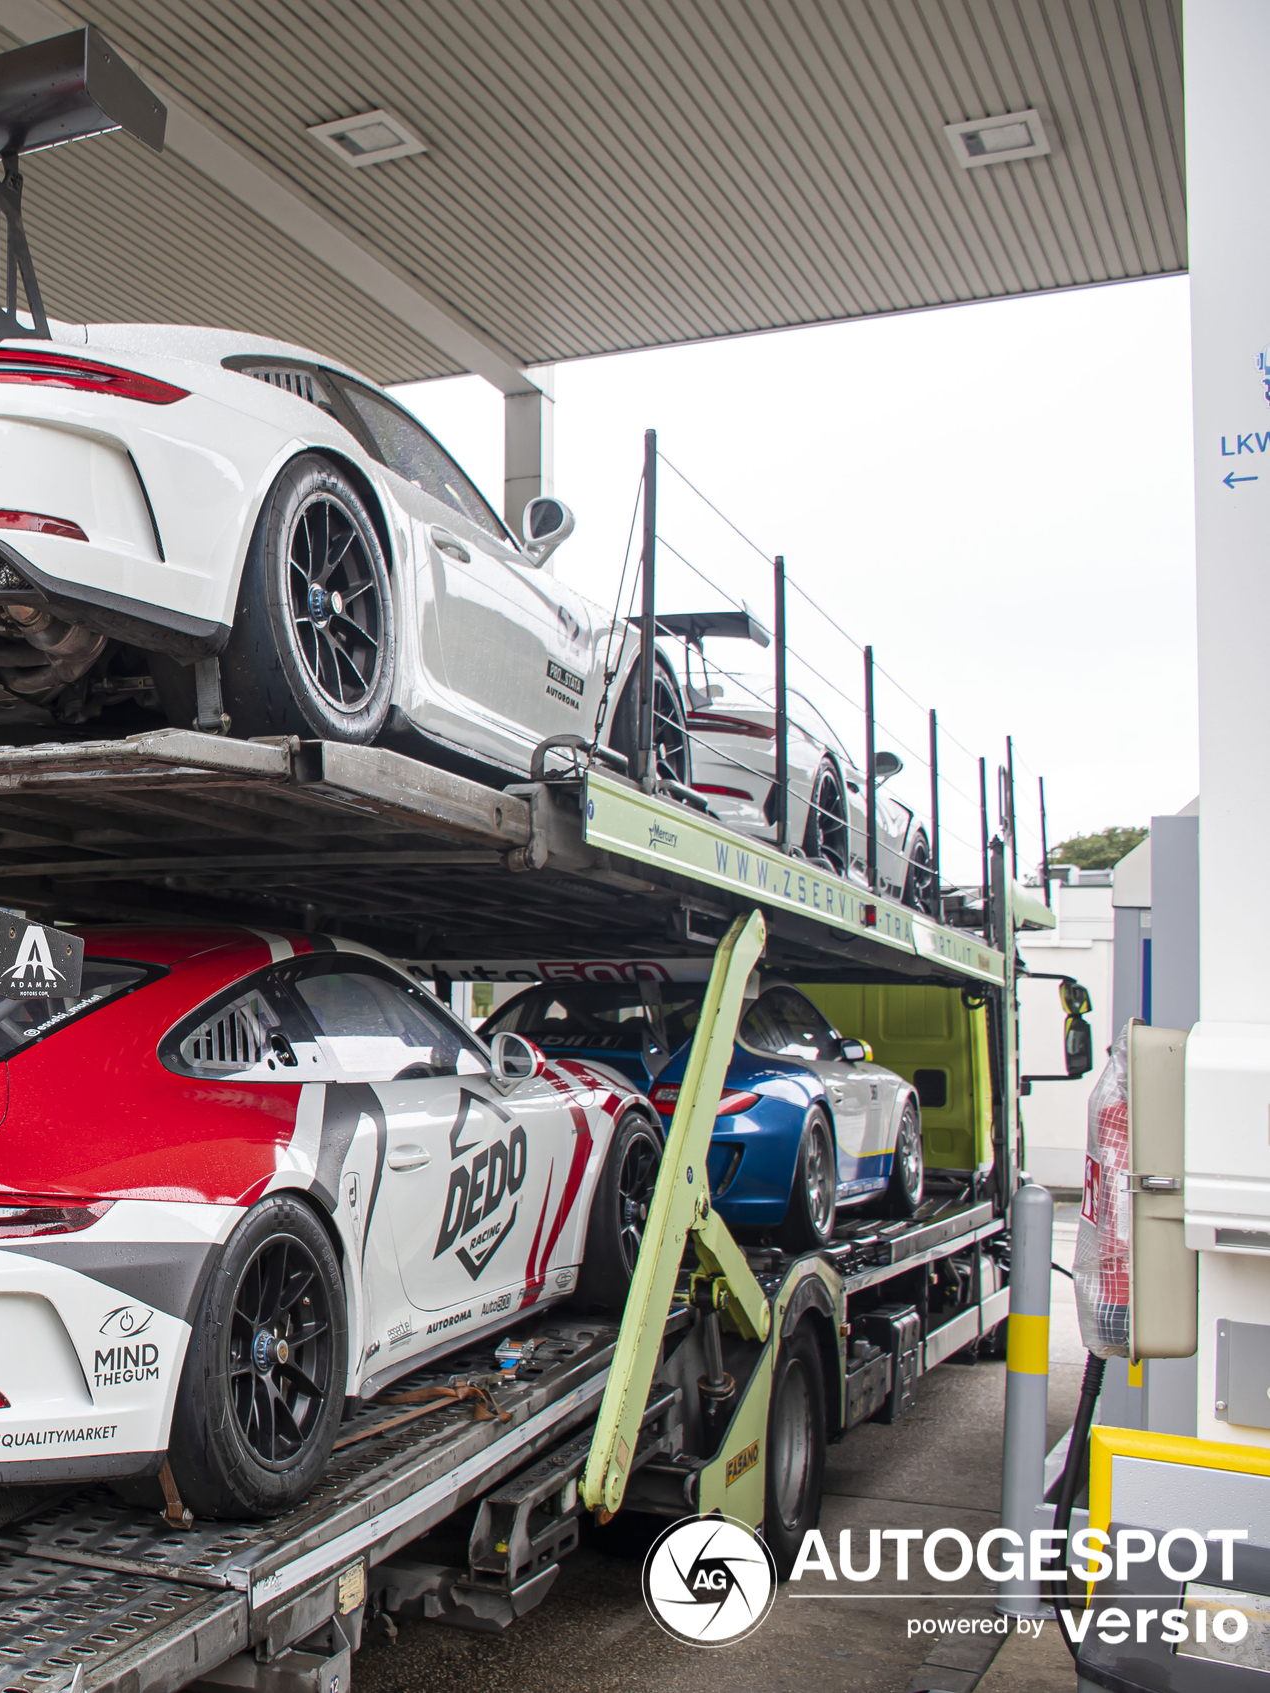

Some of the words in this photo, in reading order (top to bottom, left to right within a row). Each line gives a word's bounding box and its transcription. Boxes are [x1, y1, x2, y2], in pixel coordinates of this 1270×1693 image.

[546, 685, 580, 711] AUTOROMA
[654, 823, 678, 845] Mercury
[10, 981, 58, 989] ADAMAS
[433, 1125, 527, 1261] DEDO
[469, 1221, 501, 1251] RACING
[426, 1309, 472, 1336] AUTOROMA
[94, 1343, 159, 1373] MIND
[94, 1366, 159, 1388] THEGUM
[727, 1443, 759, 1482] FASANO
